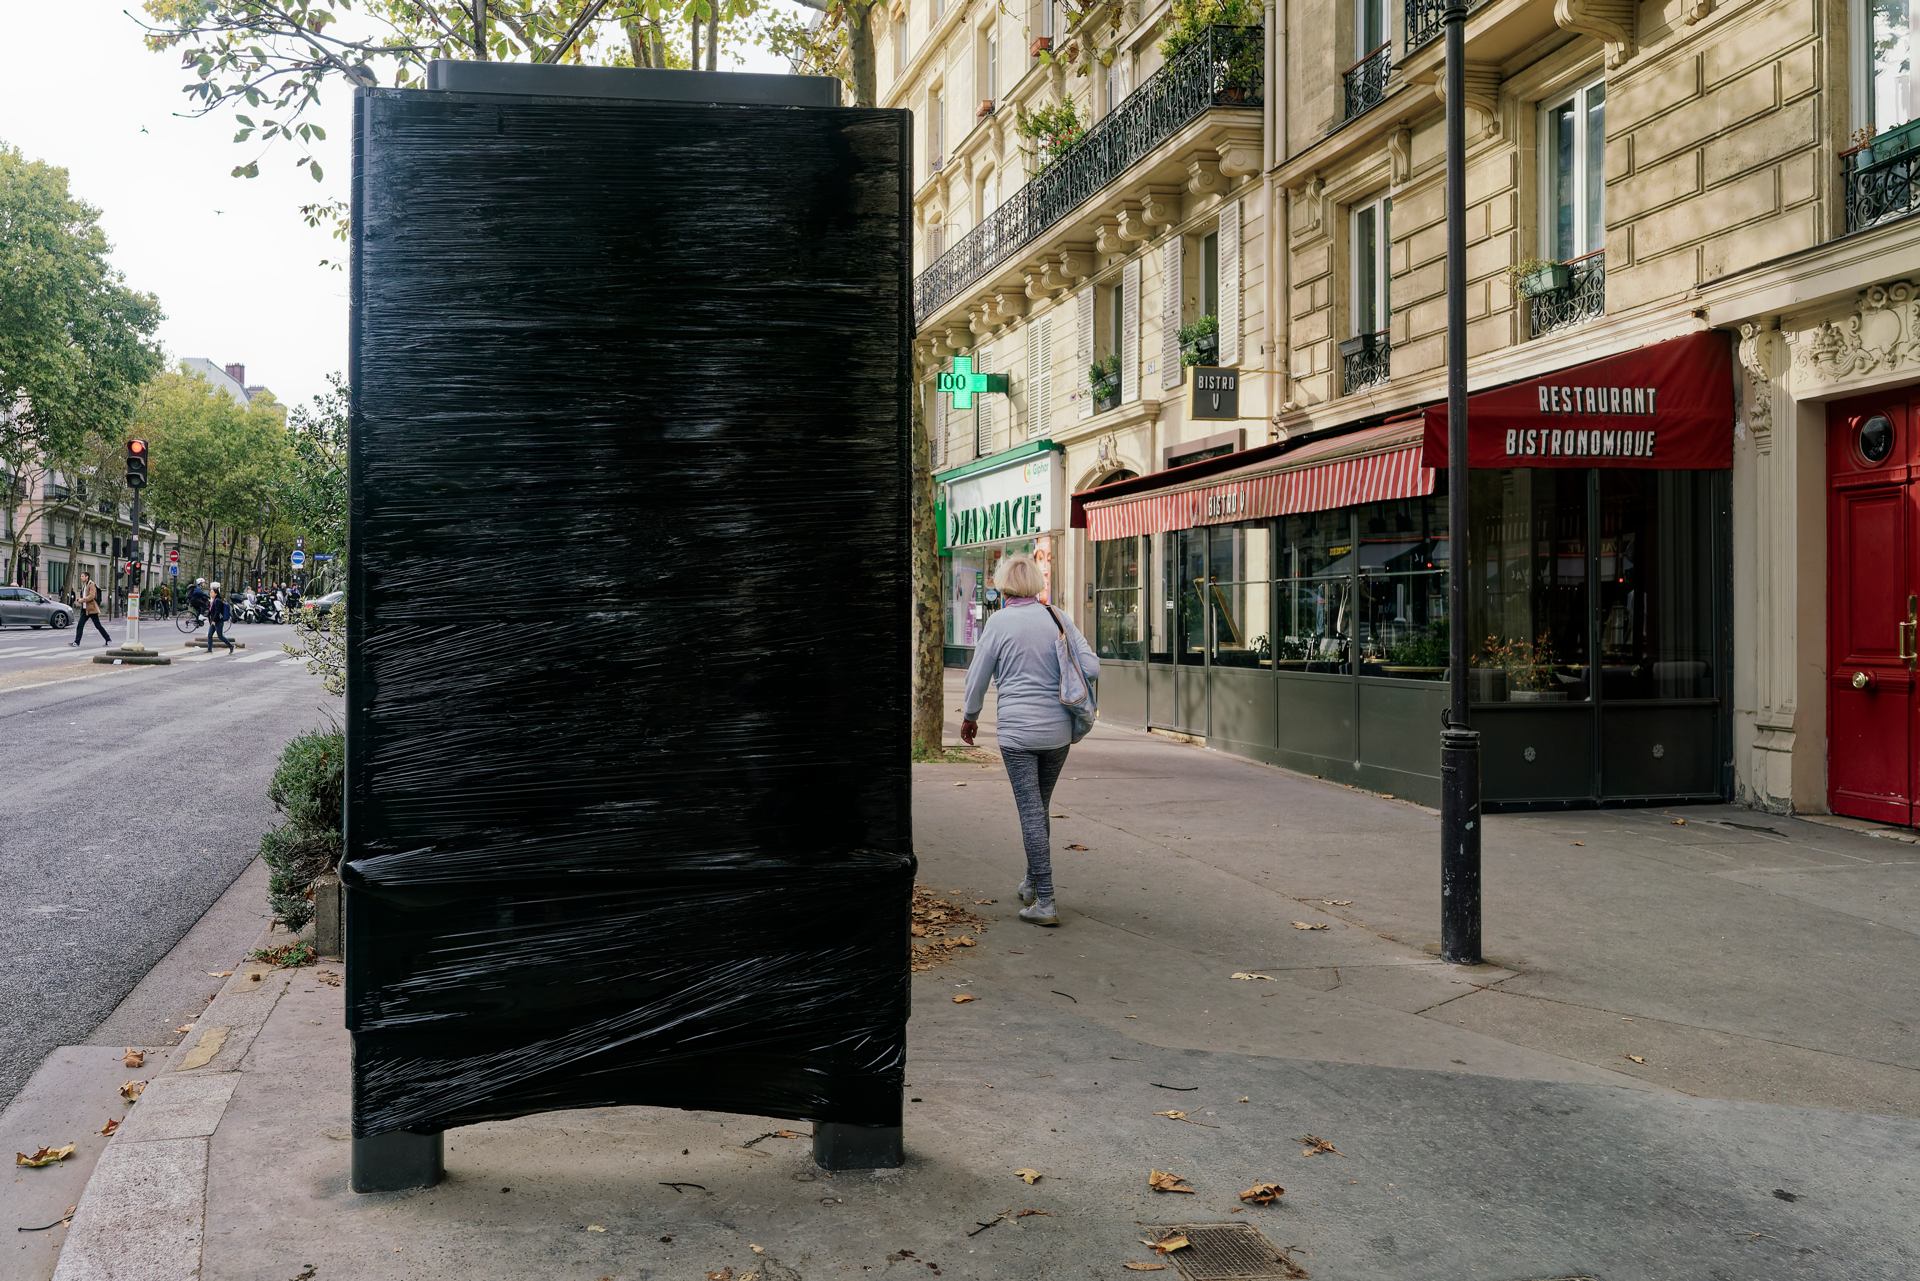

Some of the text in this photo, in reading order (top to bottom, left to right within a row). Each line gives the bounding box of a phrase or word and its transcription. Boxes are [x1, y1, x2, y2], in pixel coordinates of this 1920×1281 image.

[1198, 375, 1235, 391] BISTRO
[1212, 393, 1221, 410] V
[1538, 385, 1656, 414] RESTAURANT
[1505, 428, 1656, 457] BISTRONOMIQUE
[1208, 490, 1245, 517] BISTRO V
[951, 493, 1042, 547] PHARMACIE
